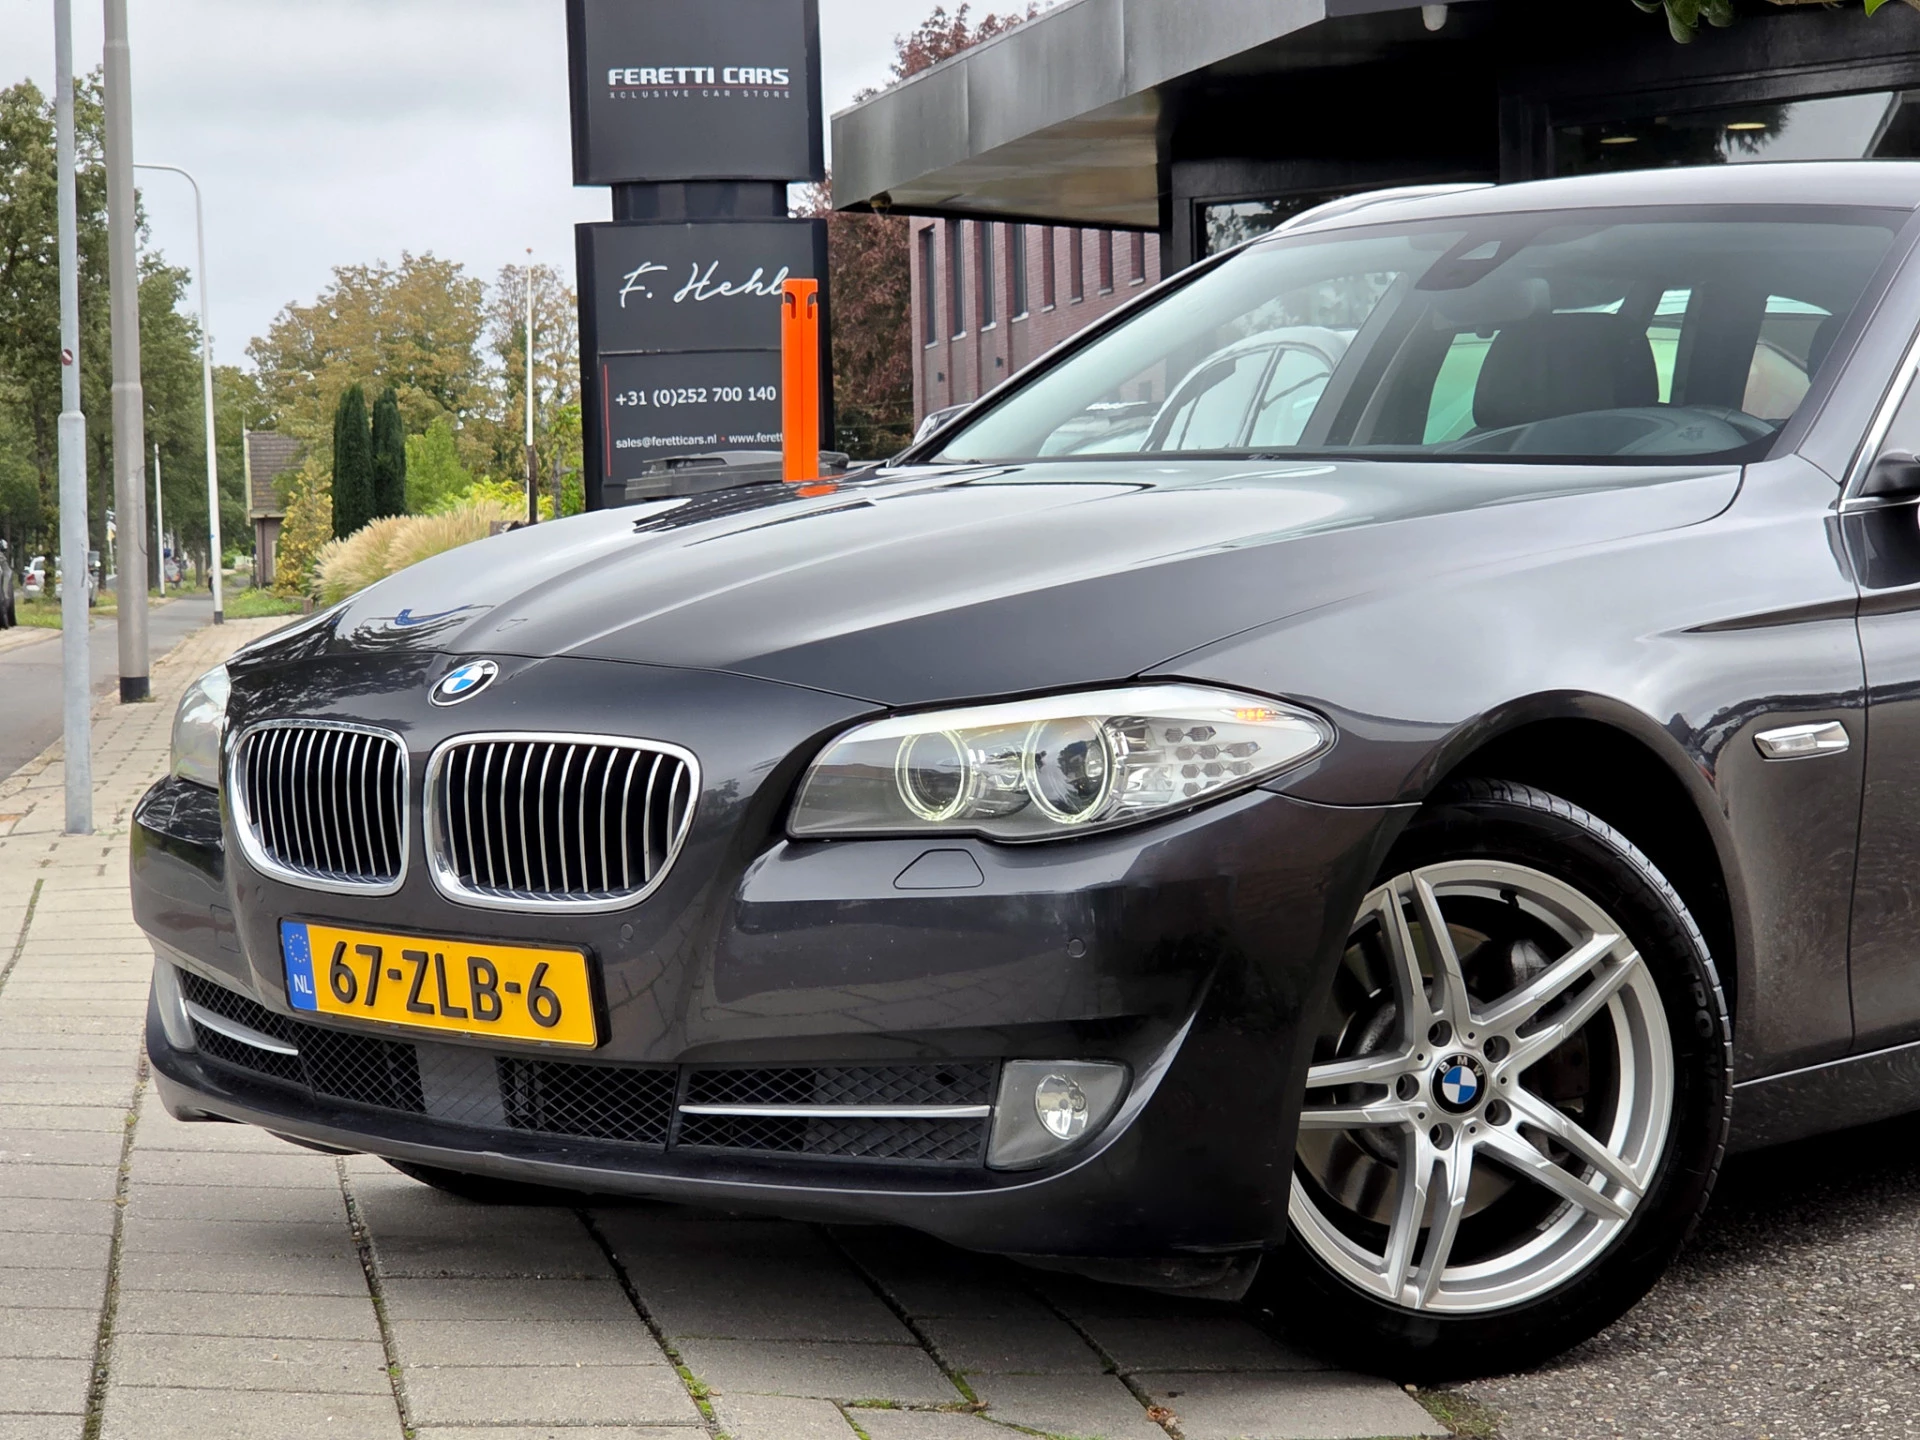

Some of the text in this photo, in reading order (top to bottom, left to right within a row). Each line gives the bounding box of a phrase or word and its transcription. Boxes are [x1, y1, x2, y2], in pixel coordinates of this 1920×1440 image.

[608, 67, 789, 85] FERETTI CARS
[703, 90, 731, 98] CAR
[743, 90, 790, 99] STORE
[619, 261, 668, 308] F.
[615, 386, 776, 408] +31 (0)252 700 140
[615, 433, 717, 448] sales@feretticars.nl
[293, 973, 313, 995] NL
[329, 940, 562, 1028] 67-ZLB-6
[1439, 1055, 1484, 1077] BMW
